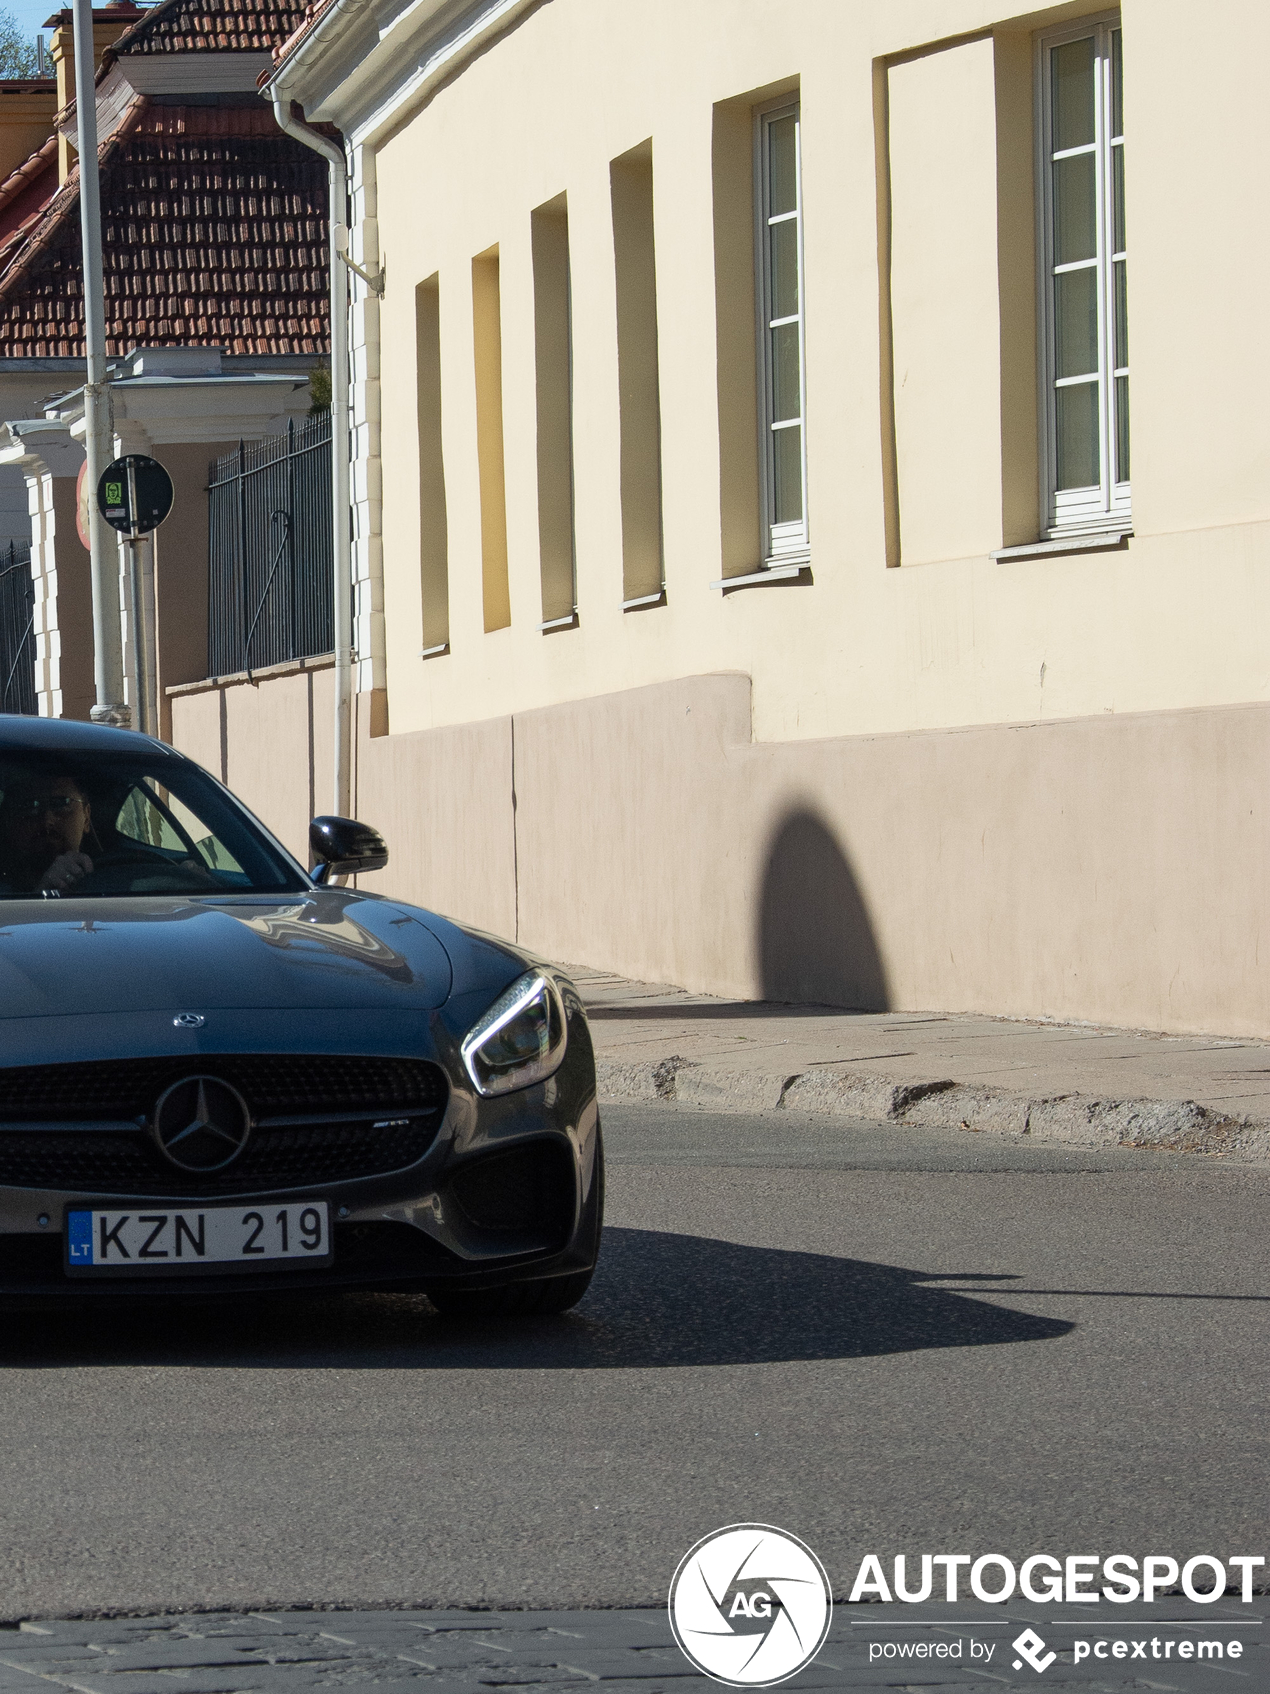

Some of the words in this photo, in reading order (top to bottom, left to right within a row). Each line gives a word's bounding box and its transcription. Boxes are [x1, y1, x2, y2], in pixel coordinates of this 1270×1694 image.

[100, 1214, 205, 1259] KZN
[242, 1208, 322, 1254] 219
[71, 1244, 90, 1256] LT
